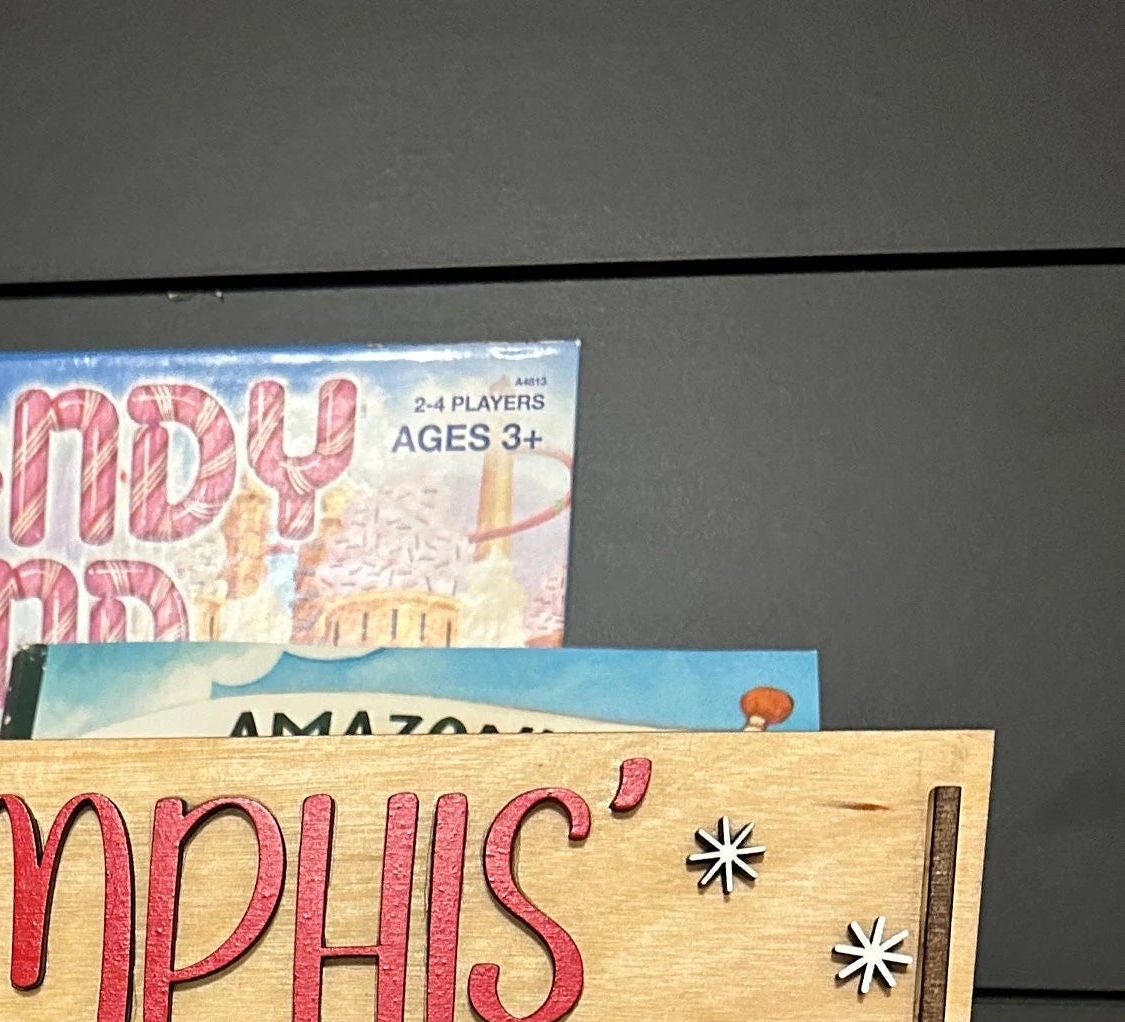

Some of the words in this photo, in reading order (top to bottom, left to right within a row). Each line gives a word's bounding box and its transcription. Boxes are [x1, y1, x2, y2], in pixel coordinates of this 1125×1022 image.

[414, 397, 445, 413] 2-4
[452, 394, 545, 412] PLAYERS
[392, 424, 491, 453] AGES
[501, 423, 543, 451] 3+
